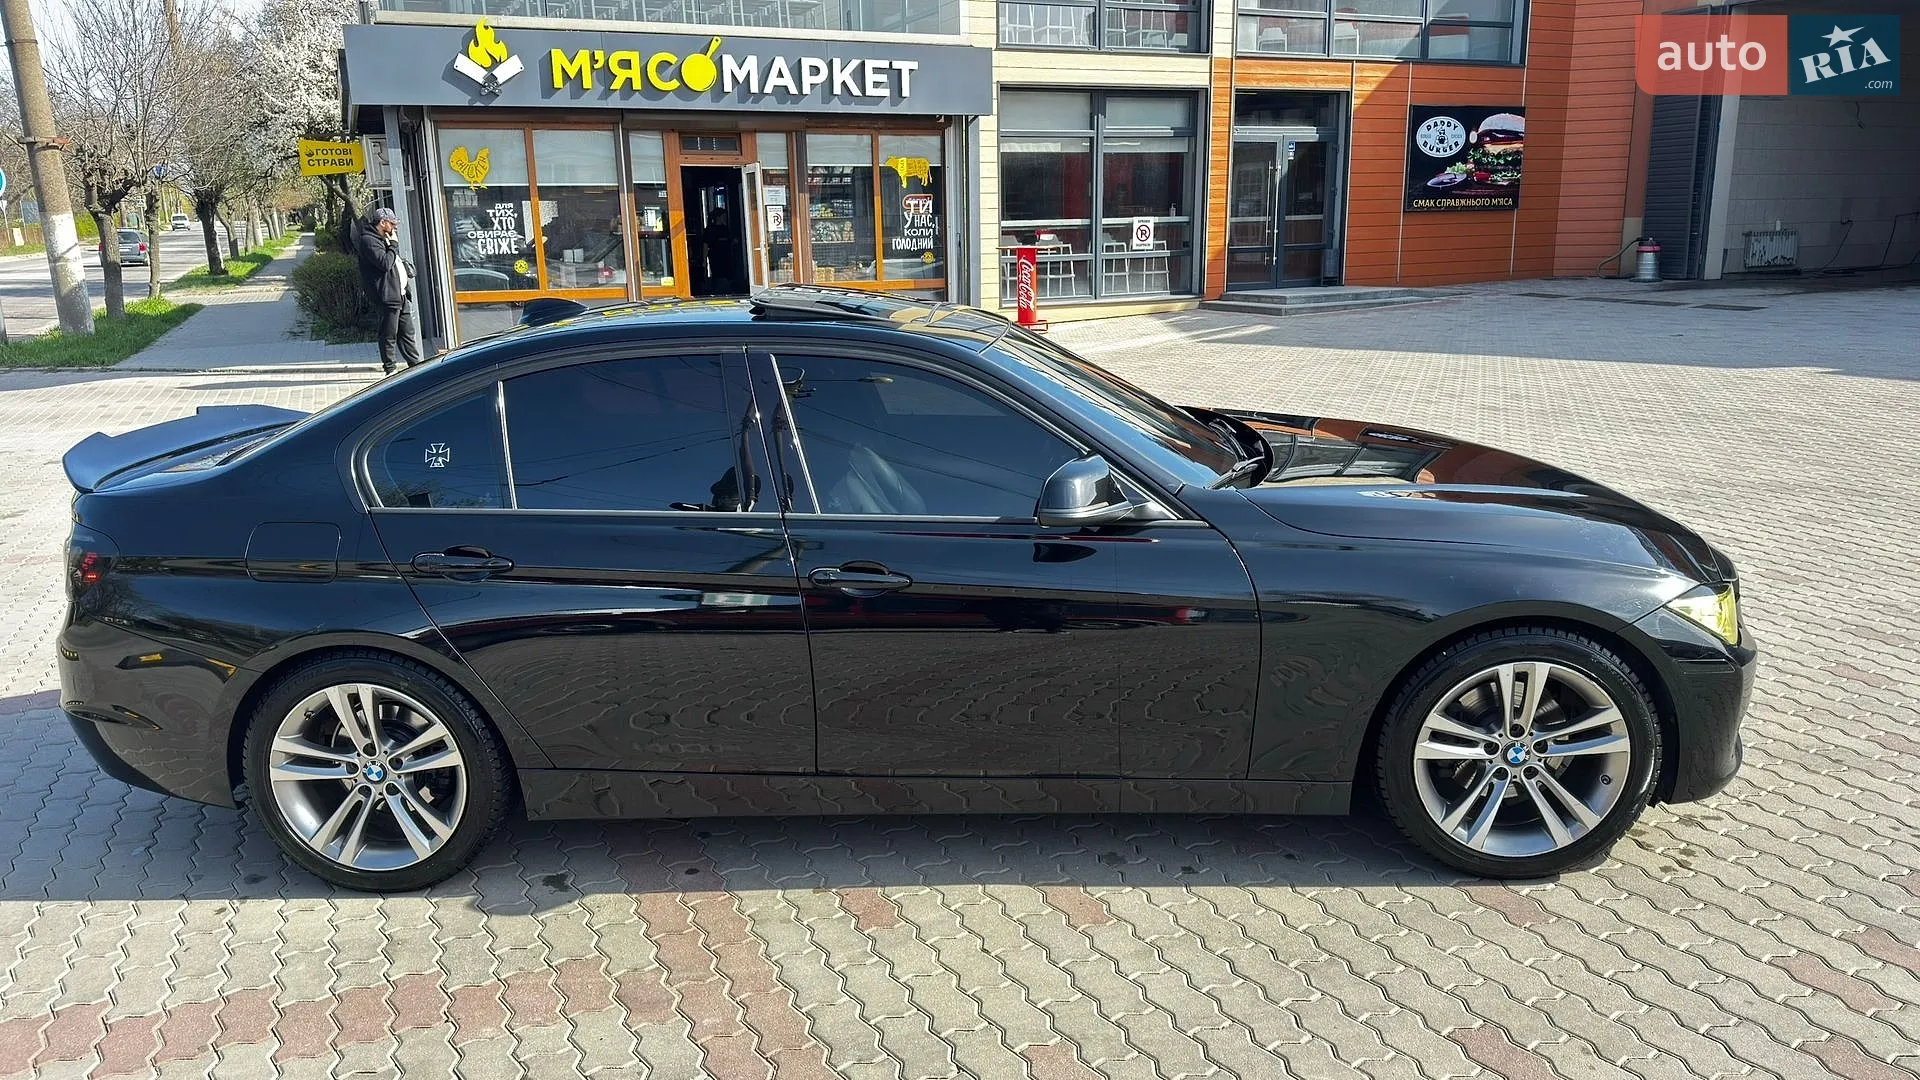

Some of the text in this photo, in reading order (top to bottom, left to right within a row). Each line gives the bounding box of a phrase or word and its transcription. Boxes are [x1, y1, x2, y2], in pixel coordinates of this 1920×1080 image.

[1426, 120, 1459, 131] DADDY
[315, 148, 352, 156] ГОТОВІ
[1422, 140, 1460, 153] BURGER
[307, 158, 354, 167] СТРАВИ
[905, 199, 933, 214] ТИ
[1413, 197, 1513, 208] СМАК СПРАВЖНЬОГО М'ЯСА
[486, 209, 519, 219] ТИХ,
[904, 211, 936, 229] У НАС,
[491, 217, 515, 230] ХТО
[467, 230, 518, 239] ОБИРАЄ
[477, 237, 519, 255] СВІЖЕ
[892, 236, 934, 252] ГОЛОДНИЙ
